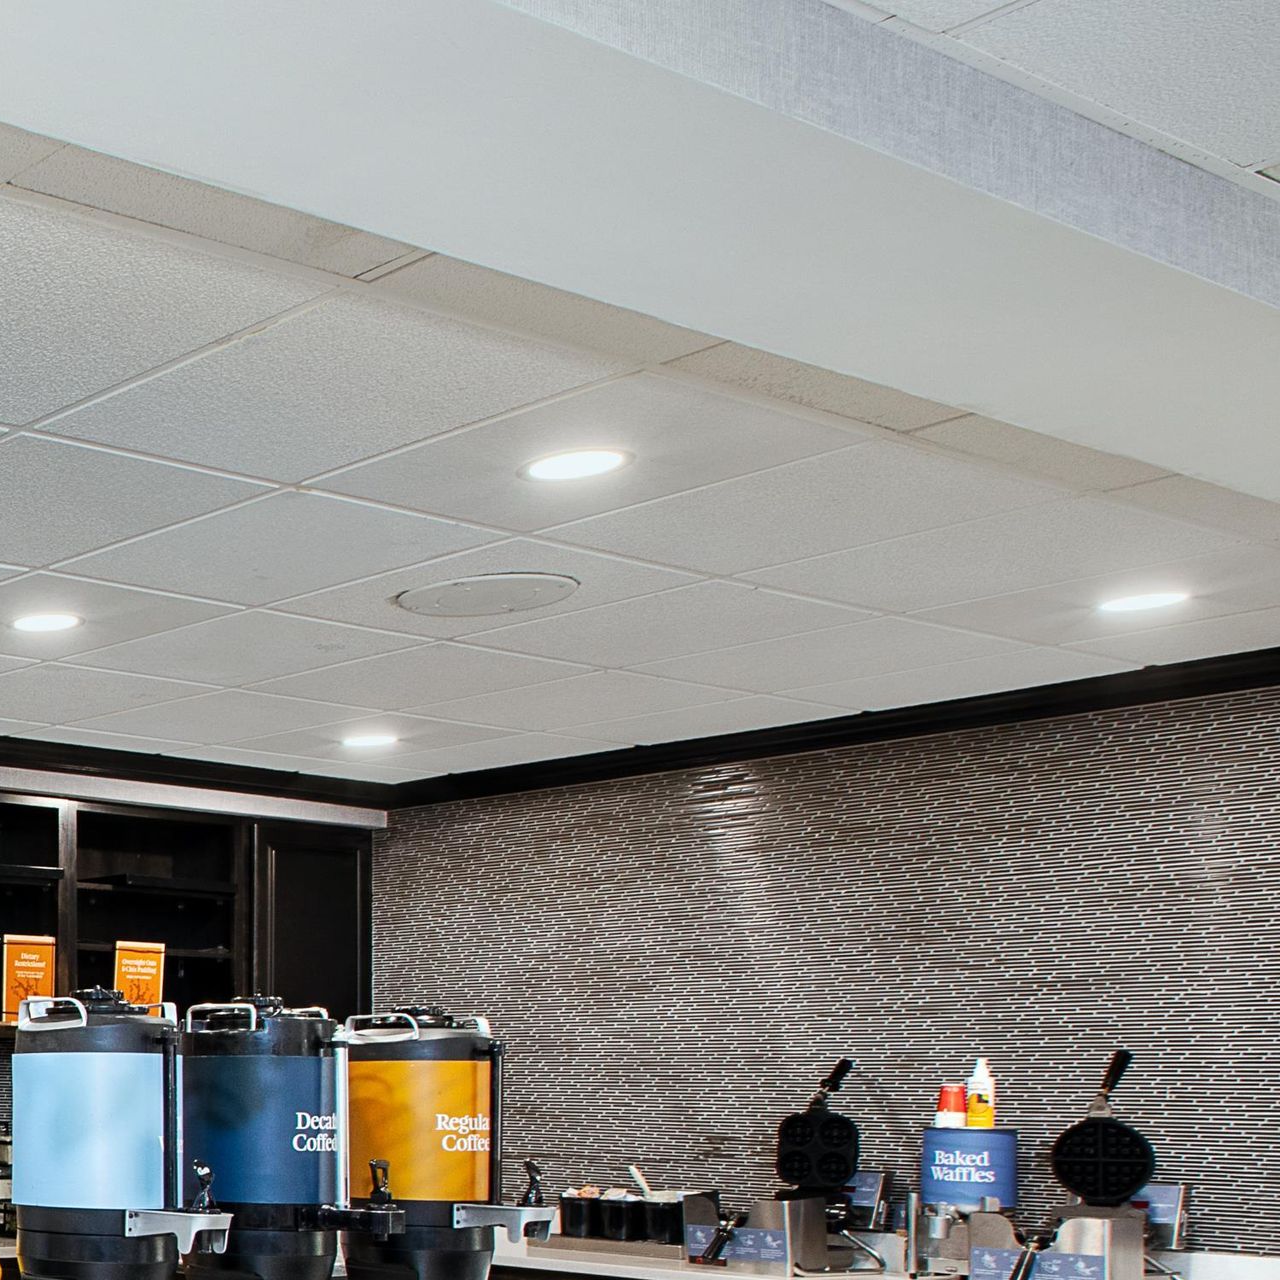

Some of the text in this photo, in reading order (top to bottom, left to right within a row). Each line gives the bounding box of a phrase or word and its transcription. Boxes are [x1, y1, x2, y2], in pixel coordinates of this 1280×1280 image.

[435, 1113, 491, 1134] Regula
[933, 1150, 991, 1167] Baked
[930, 1166, 996, 1183] Waffles
